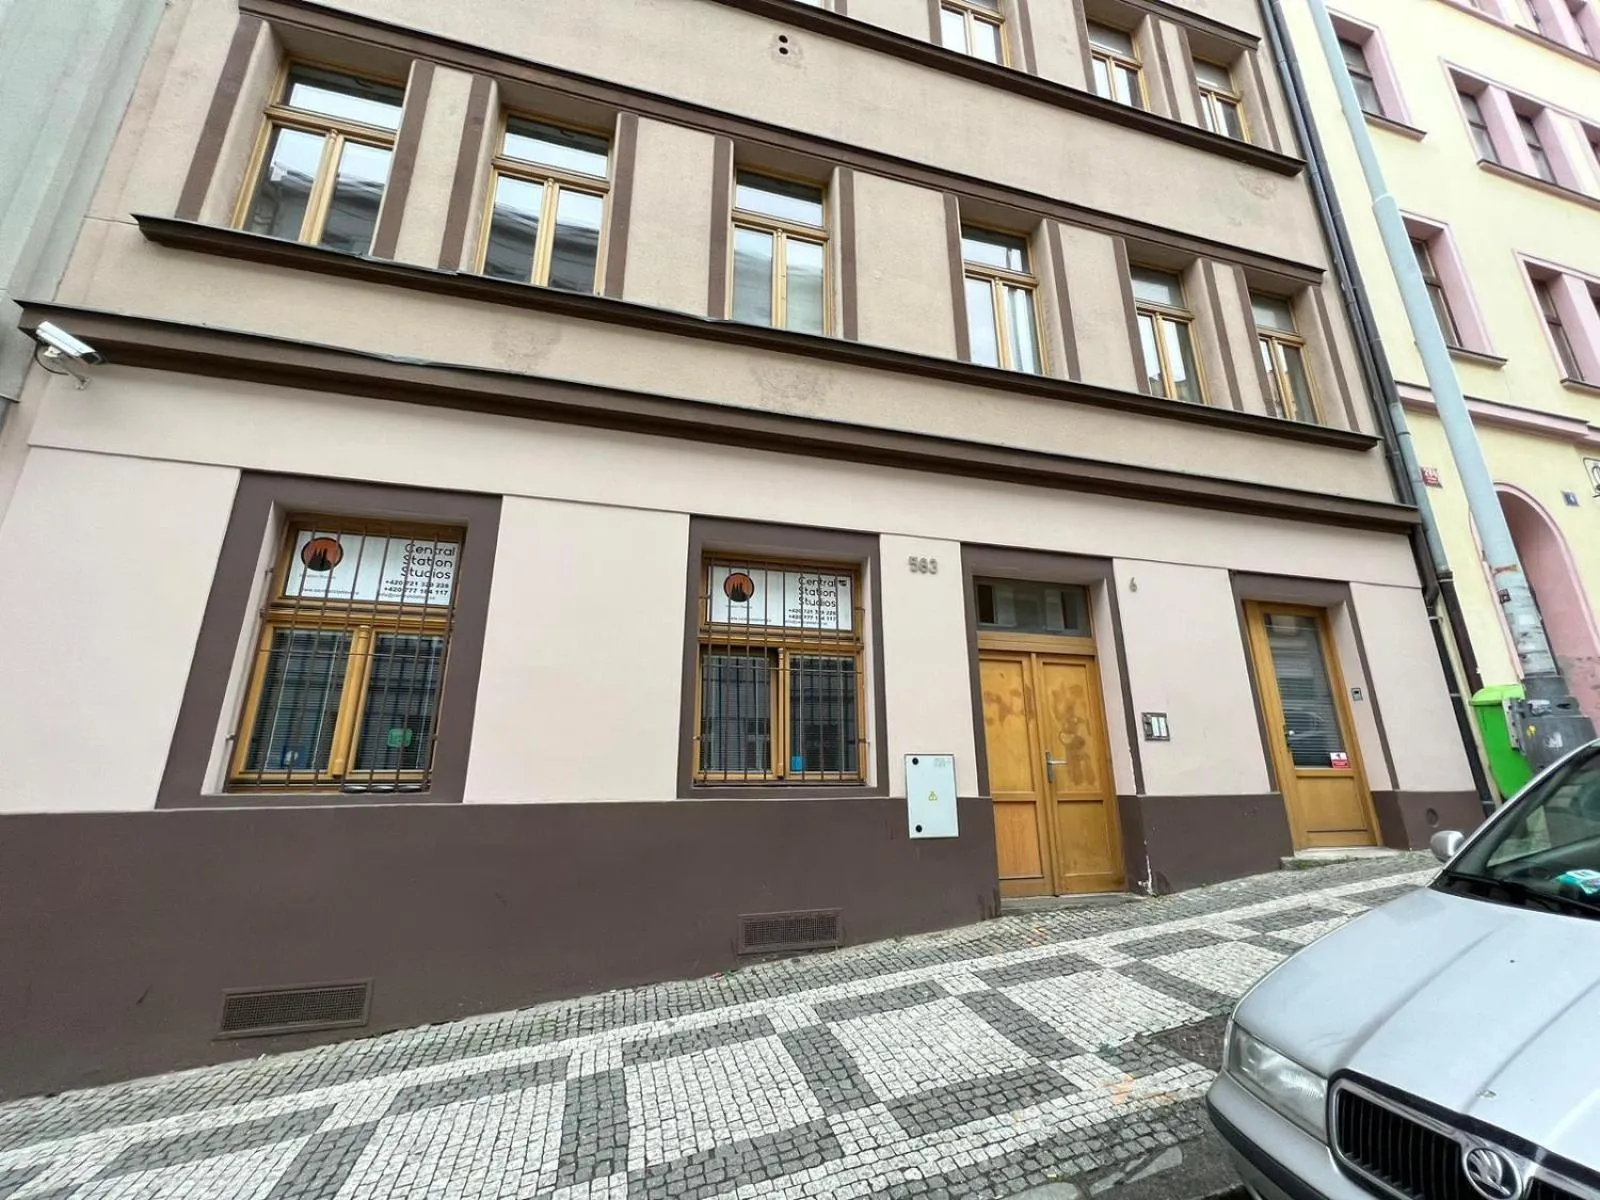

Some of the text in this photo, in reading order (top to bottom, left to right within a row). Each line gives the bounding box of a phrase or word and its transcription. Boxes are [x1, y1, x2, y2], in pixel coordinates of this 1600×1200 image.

[405, 543, 456, 556] Central
[402, 554, 453, 568] Staton
[798, 576, 837, 588] Central
[1130, 576, 1138, 593] 6
